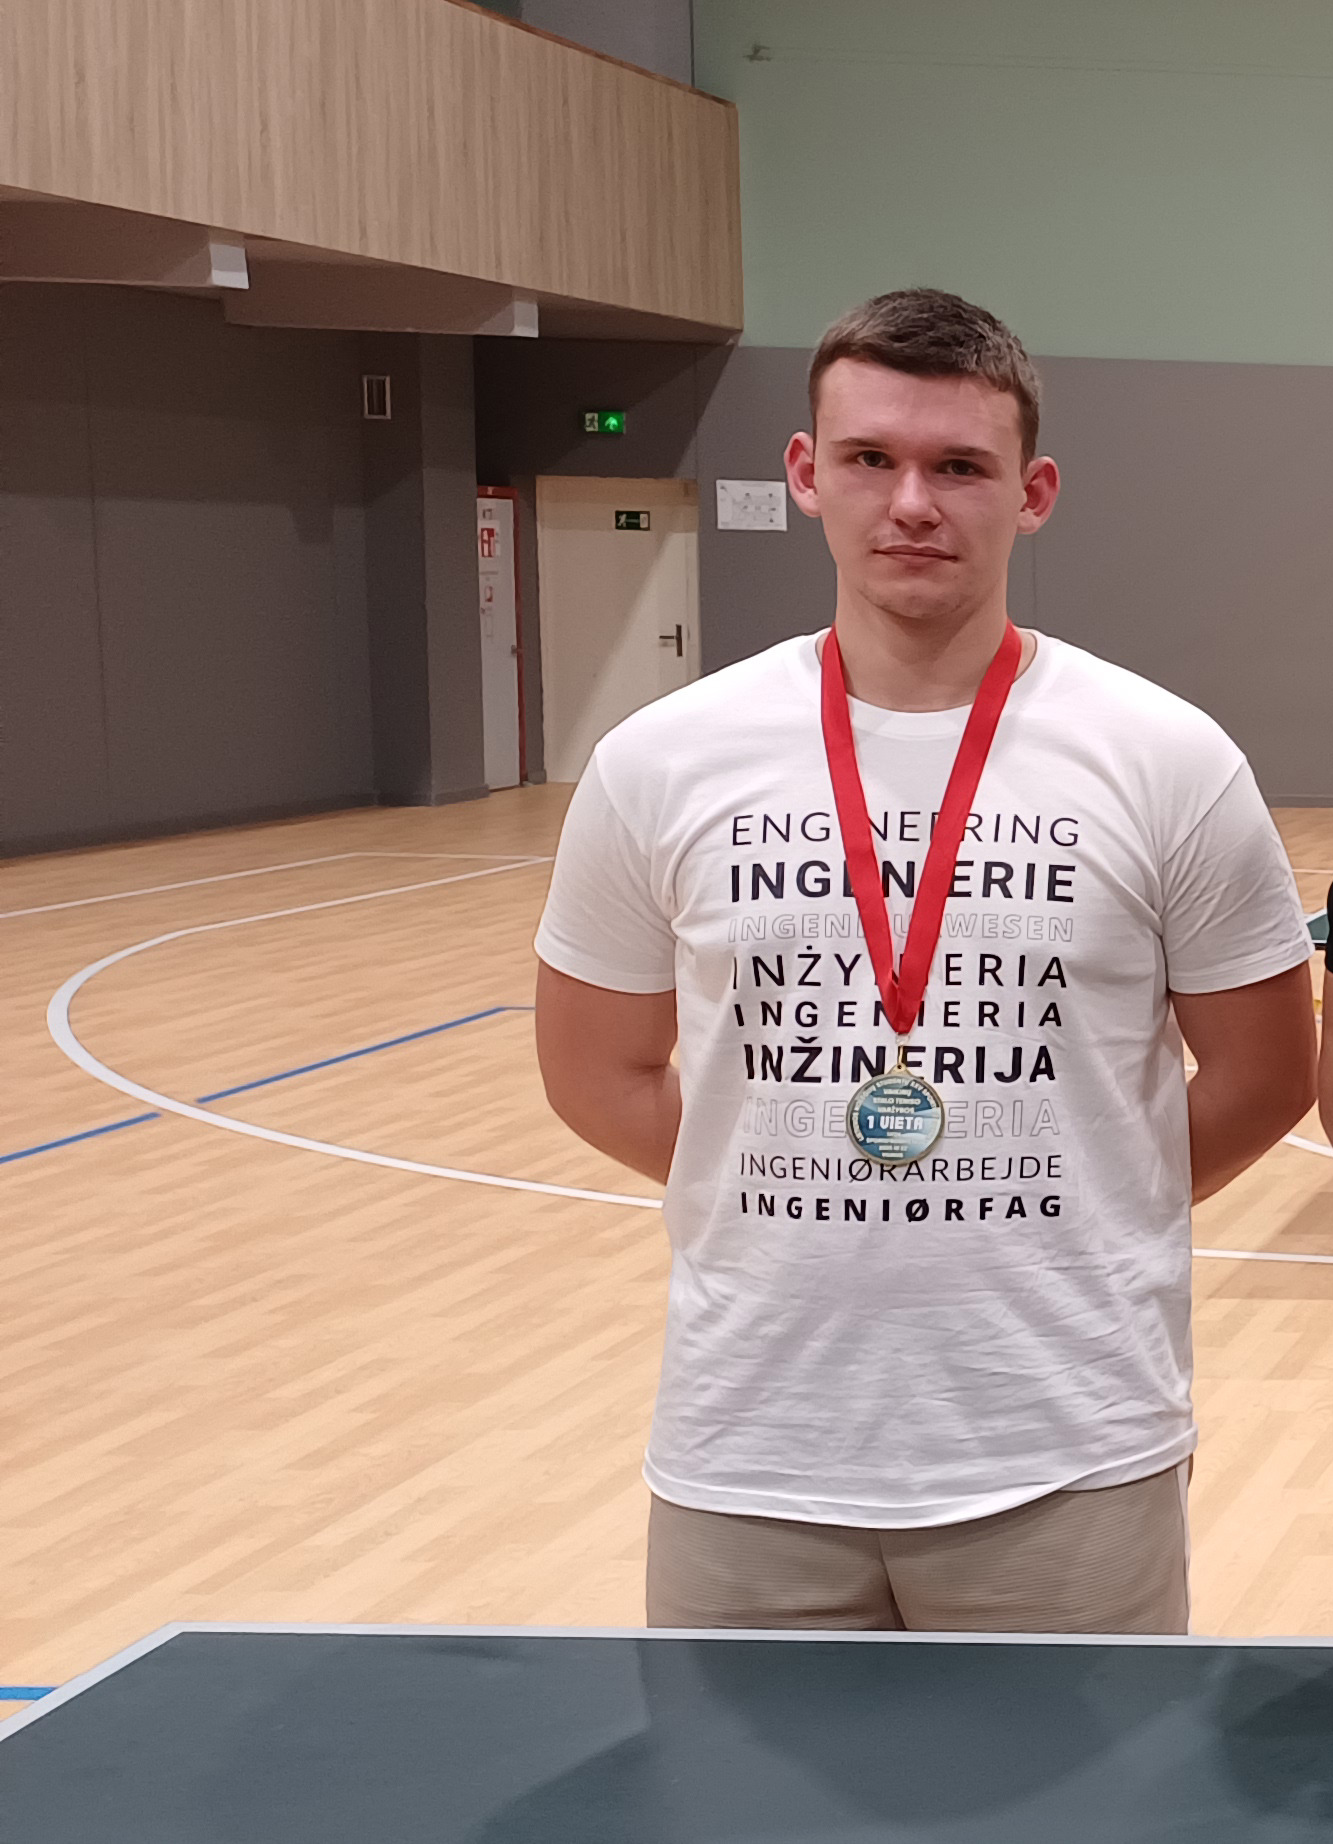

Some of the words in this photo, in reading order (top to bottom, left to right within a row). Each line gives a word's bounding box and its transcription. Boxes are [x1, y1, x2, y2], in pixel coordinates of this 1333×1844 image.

[732, 811, 1079, 847] ENGNERING
[731, 860, 1075, 902] INGNERIE
[728, 913, 1073, 942] INGENUWESEN
[733, 945, 1067, 989] INŻYERIA
[743, 1096, 1060, 1138] INGEERIA
[867, 1115, 875, 1129] 1
[740, 1152, 1062, 1183] INGENIØRARBEJDE
[741, 1192, 1061, 1222] INGENIØRFAG
